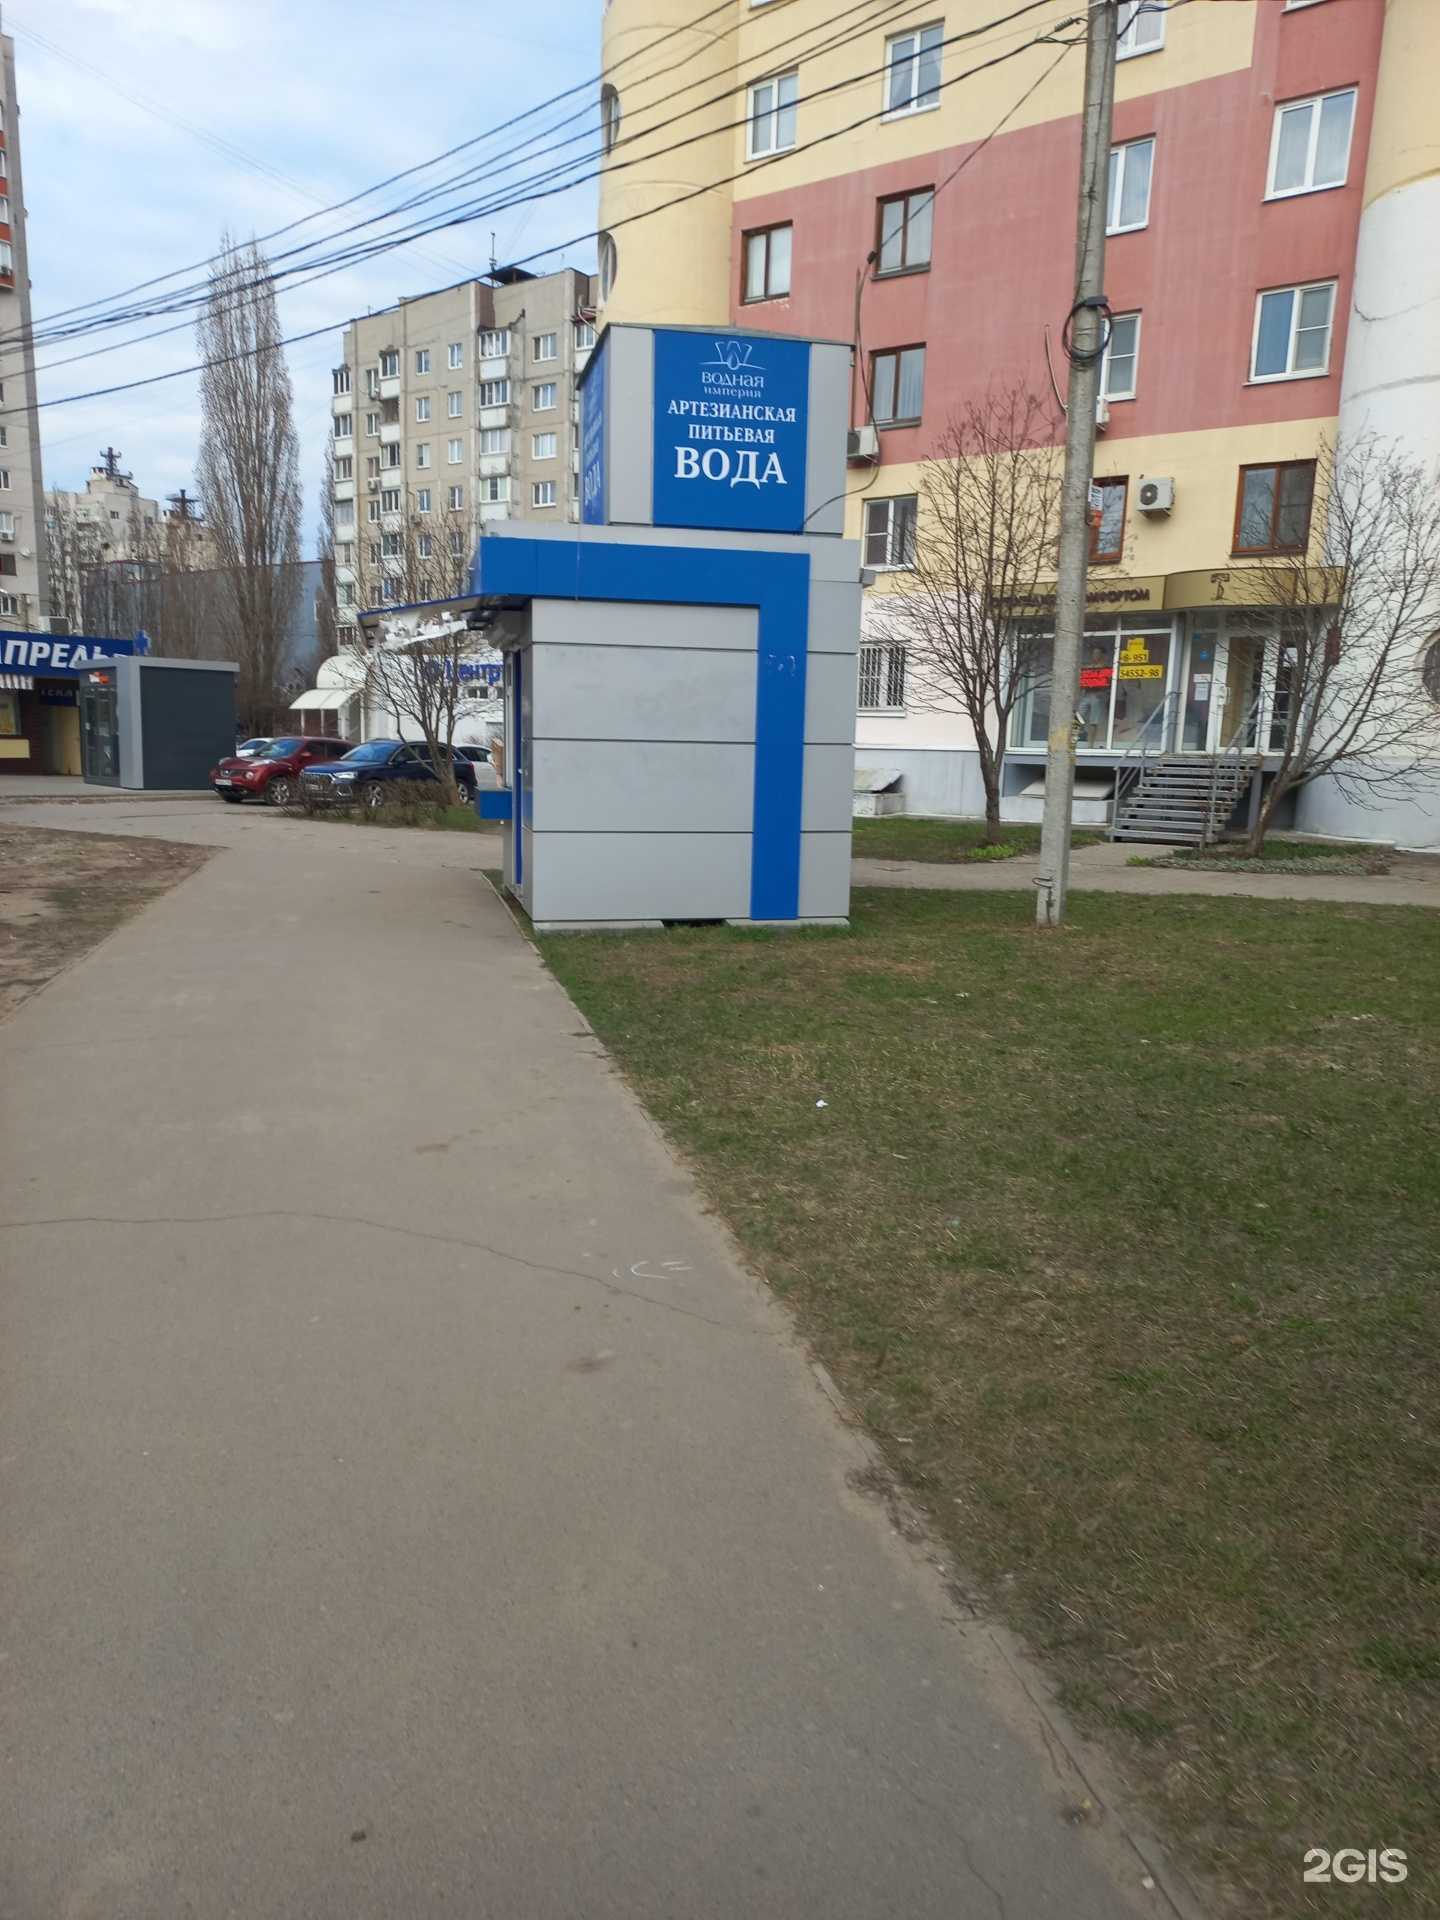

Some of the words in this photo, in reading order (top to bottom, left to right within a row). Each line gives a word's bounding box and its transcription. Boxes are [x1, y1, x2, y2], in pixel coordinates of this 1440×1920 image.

[667, 400, 796, 422] АРТЕЗИАНСКАЯ
[688, 424, 775, 444] ПИТЬЕВАЯ
[674, 446, 788, 490] ВОДА
